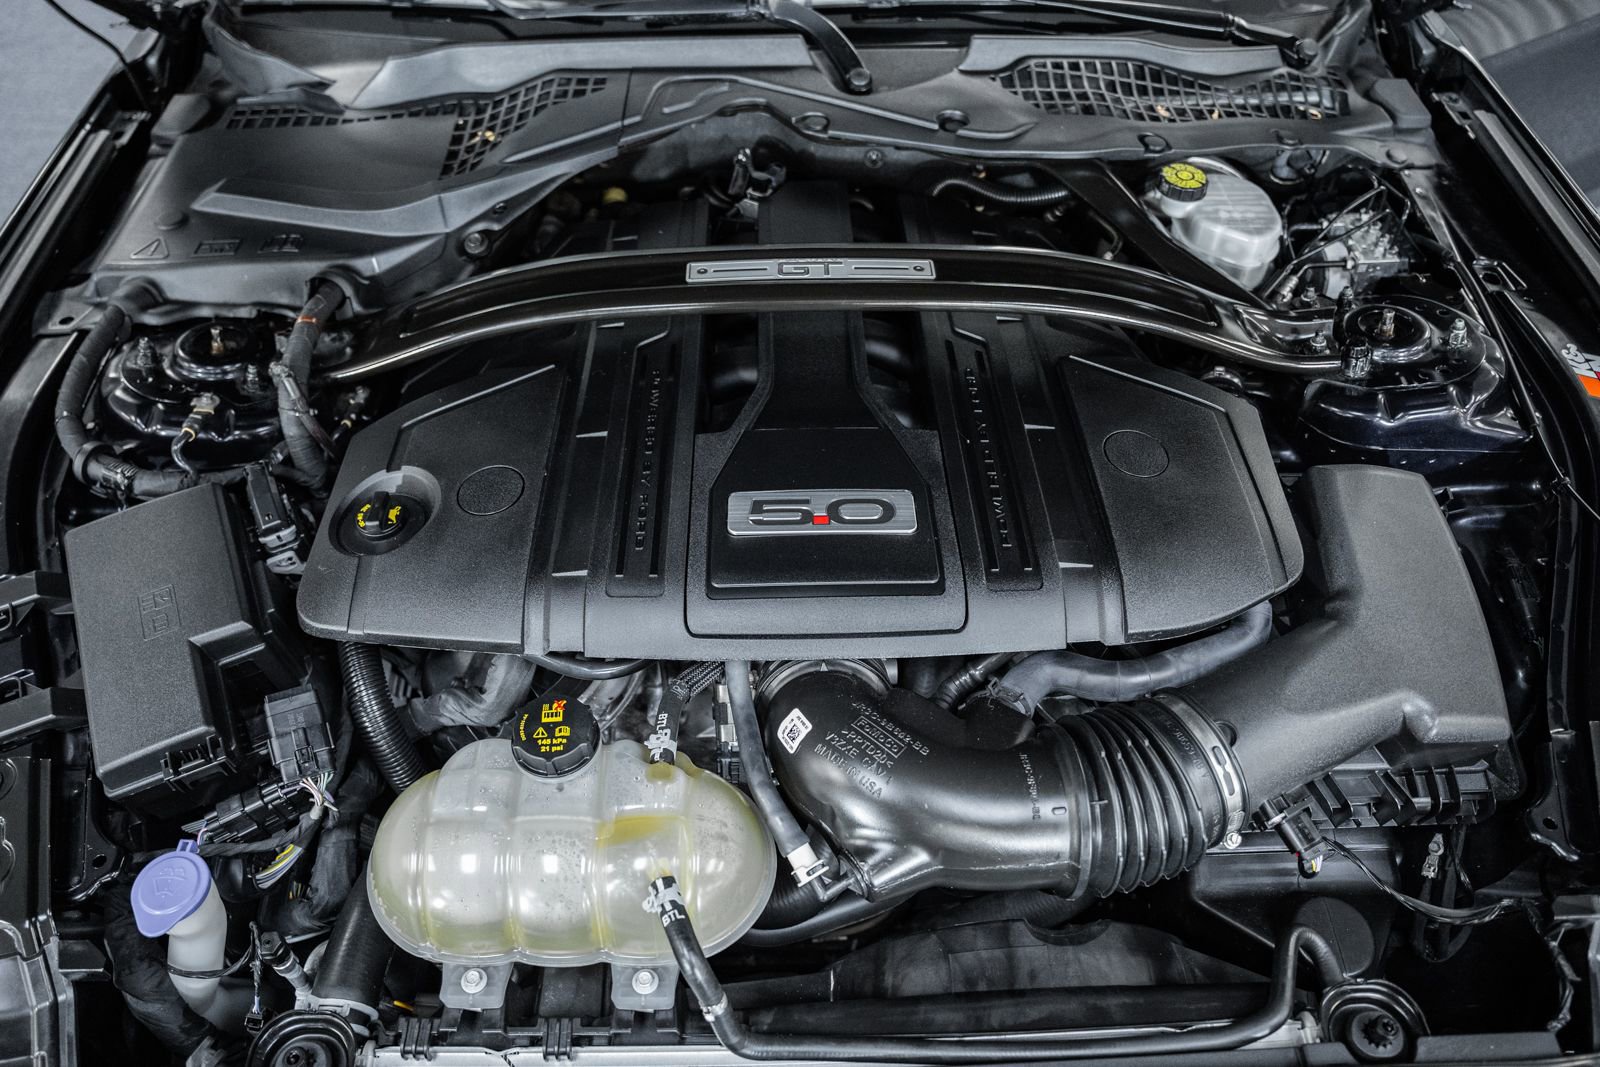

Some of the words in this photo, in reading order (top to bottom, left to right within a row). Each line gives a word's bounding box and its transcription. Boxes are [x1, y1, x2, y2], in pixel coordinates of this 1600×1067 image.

[777, 261, 844, 278] GT
[633, 494, 650, 552] FORD
[748, 498, 897, 526] 5.0
[537, 738, 551, 746] 145
[552, 737, 567, 745] kPa
[857, 719, 899, 753] FoMoCo
[540, 745, 550, 753] 21
[551, 745, 564, 753] psi
[814, 743, 848, 767] MADE
[858, 776, 883, 799] USA
[661, 908, 686, 928] BTL
